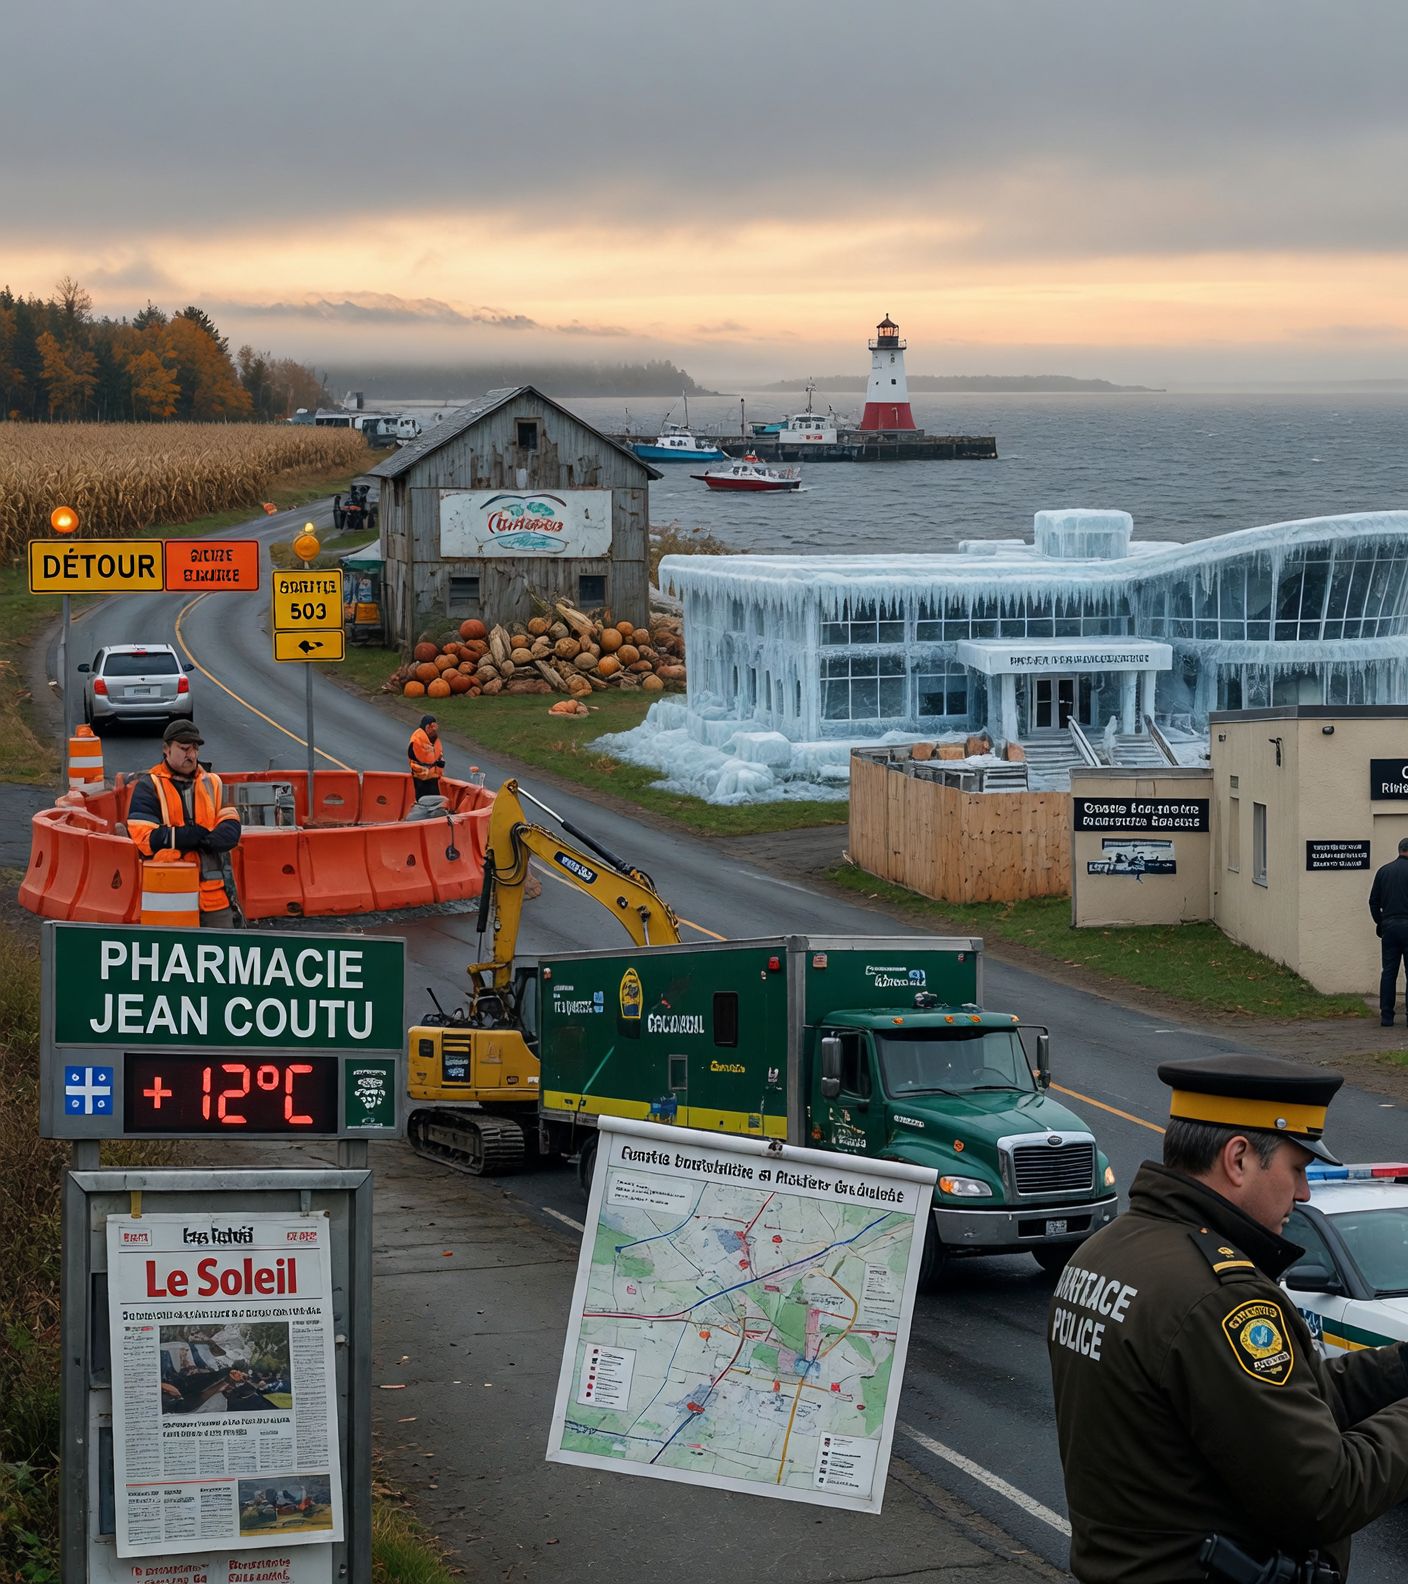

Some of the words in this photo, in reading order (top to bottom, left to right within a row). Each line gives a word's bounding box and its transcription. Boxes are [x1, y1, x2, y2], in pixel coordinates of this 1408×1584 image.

[43, 548, 155, 579] DÉTOUR
[290, 602, 327, 620] 503
[100, 940, 365, 989] PHARMACIE
[89, 993, 208, 1035] JEAN
[224, 997, 373, 1039] COUTU
[145, 1260, 189, 1297] Le
[197, 1257, 297, 1297] Soleil
[1051, 1307, 1106, 1361] POLICE
